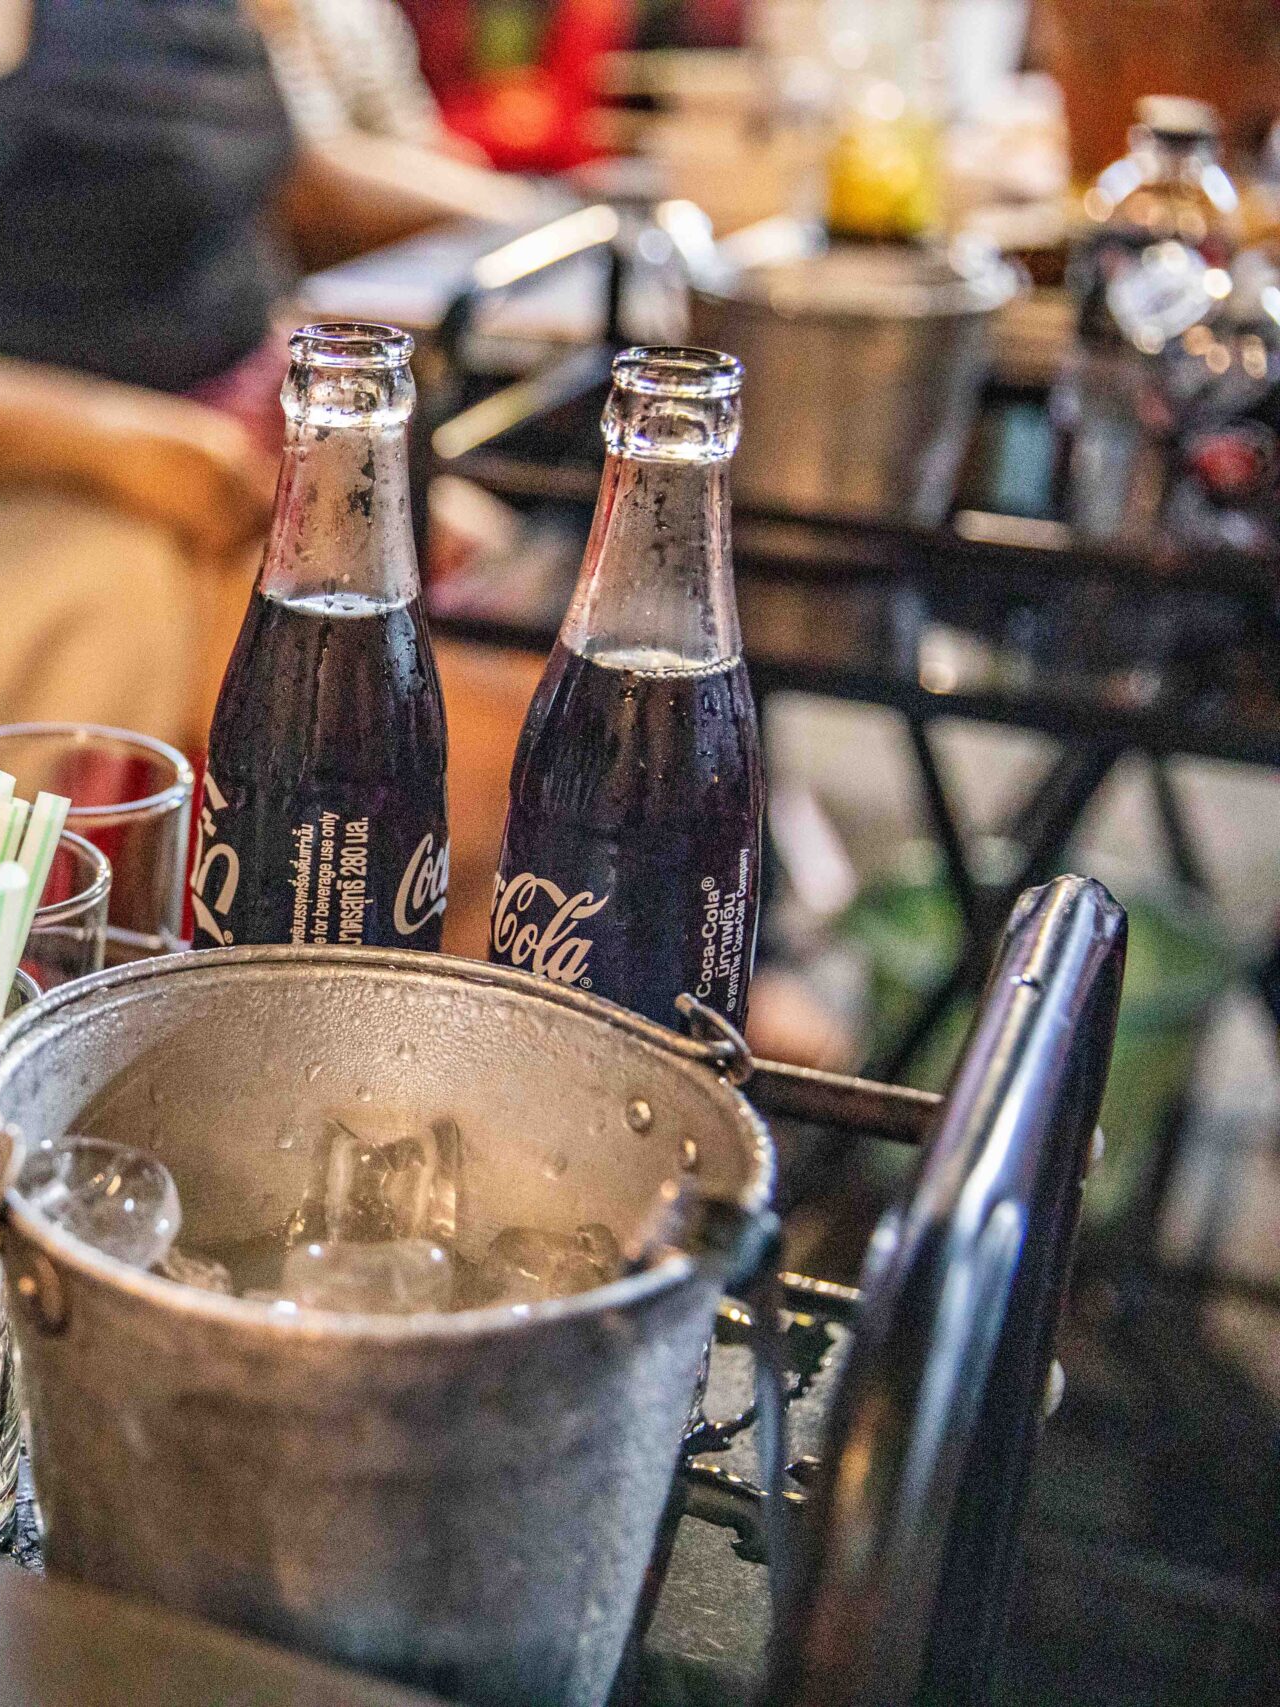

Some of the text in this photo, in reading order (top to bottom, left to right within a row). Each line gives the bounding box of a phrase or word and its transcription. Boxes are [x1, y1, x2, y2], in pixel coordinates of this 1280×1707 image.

[319, 811, 341, 837] only
[320, 839, 335, 861] use
[339, 846, 369, 876] 280
[736, 847, 750, 898] Company
[312, 863, 337, 917] beverage
[310, 918, 329, 935] for
[732, 899, 746, 952] Coca-Cola
